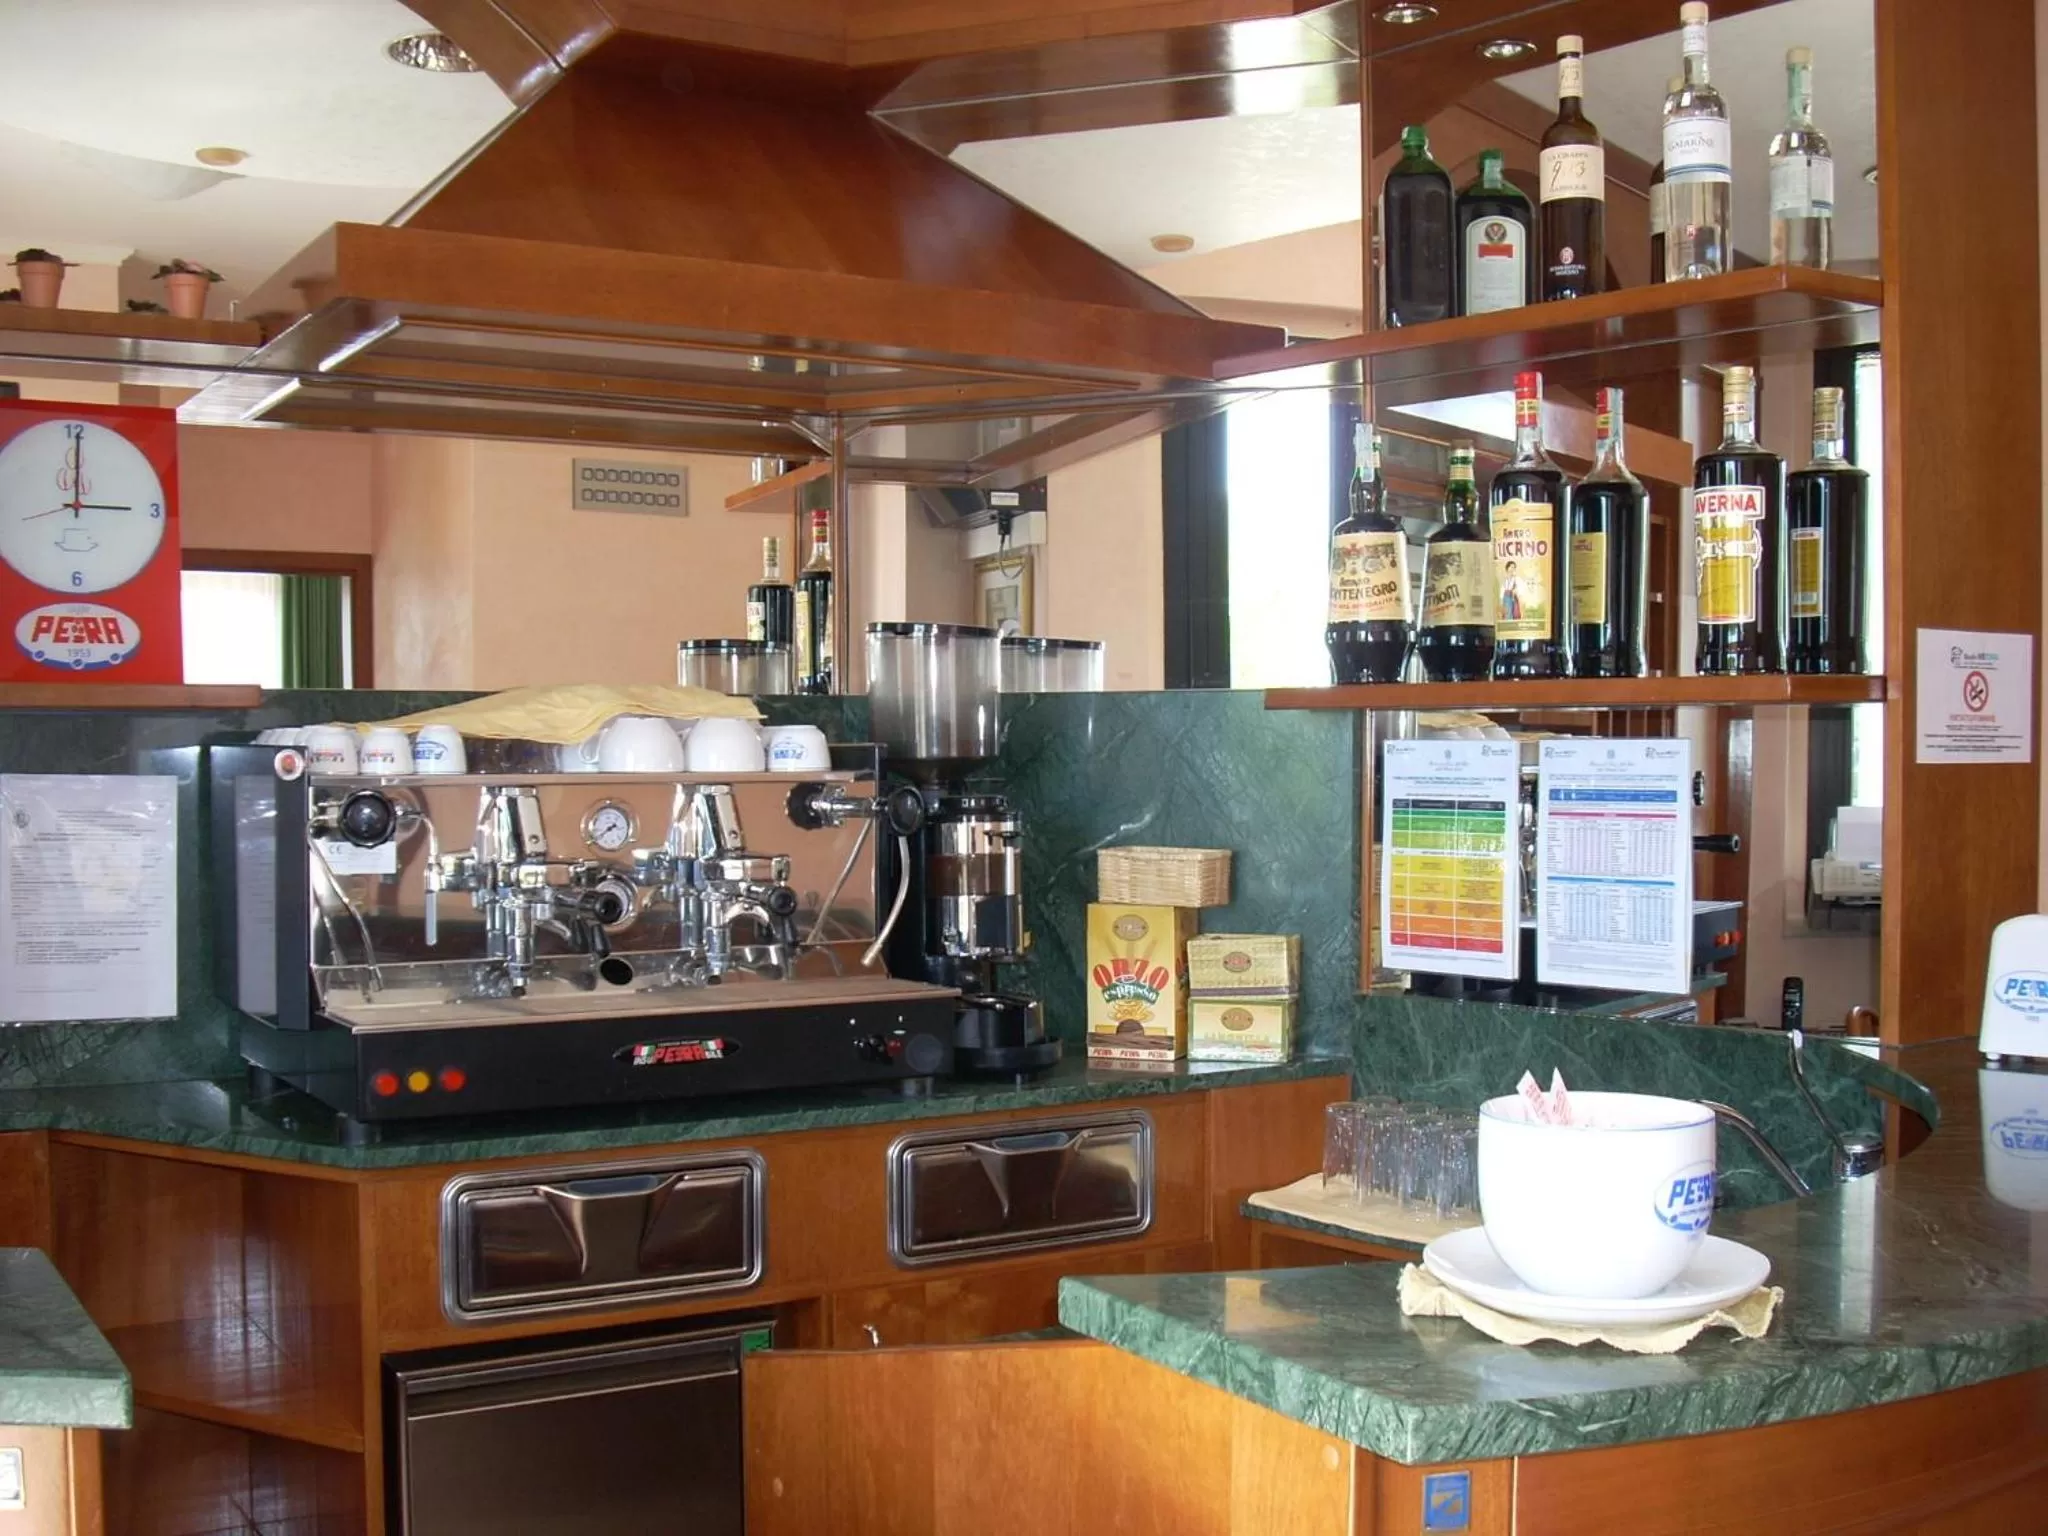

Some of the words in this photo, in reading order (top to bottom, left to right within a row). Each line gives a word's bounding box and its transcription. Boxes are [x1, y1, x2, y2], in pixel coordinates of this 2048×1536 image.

[64, 424, 84, 440] 12
[150, 503, 161, 519] 3
[71, 571, 83, 587] 6
[31, 615, 125, 644] PERA
[2003, 978, 2048, 998] PER
